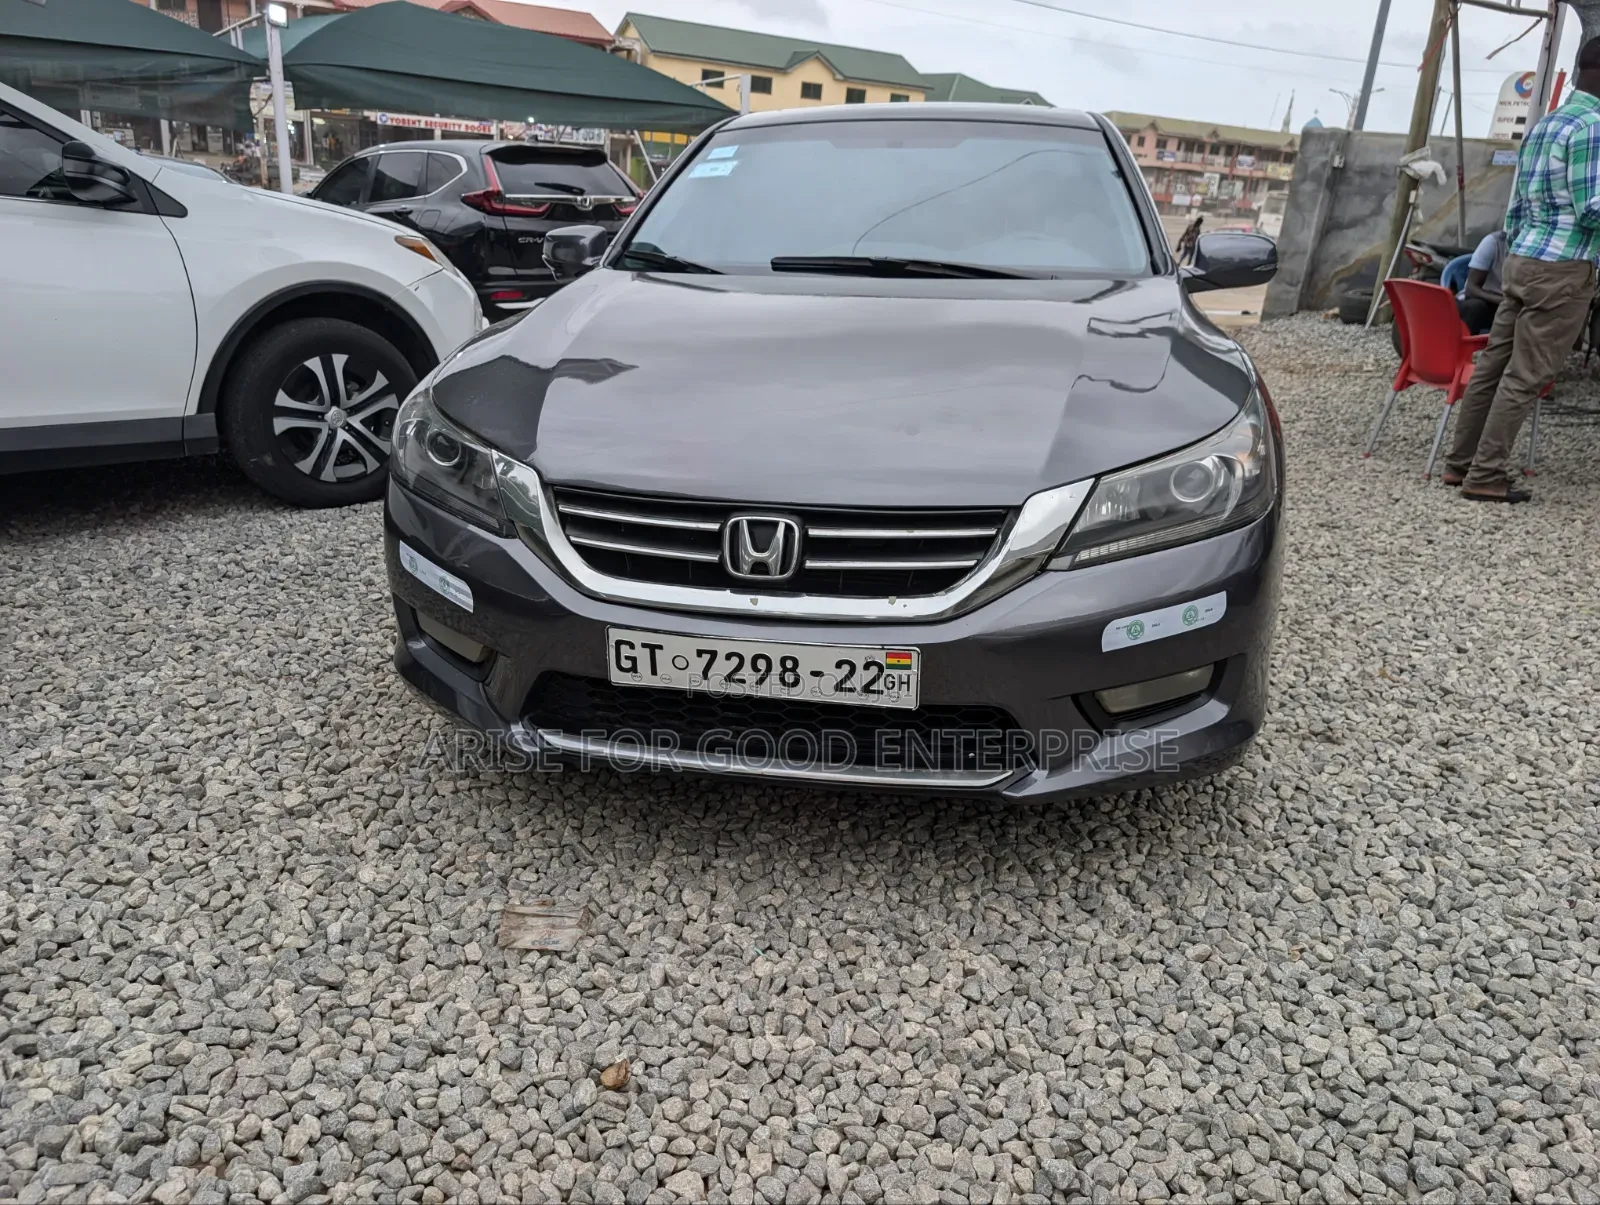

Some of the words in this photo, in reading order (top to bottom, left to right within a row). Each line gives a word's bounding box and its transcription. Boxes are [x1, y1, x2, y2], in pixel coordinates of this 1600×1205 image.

[518, 236, 544, 244] CR-V
[613, 638, 664, 676] GT
[883, 672, 911, 693] GH
